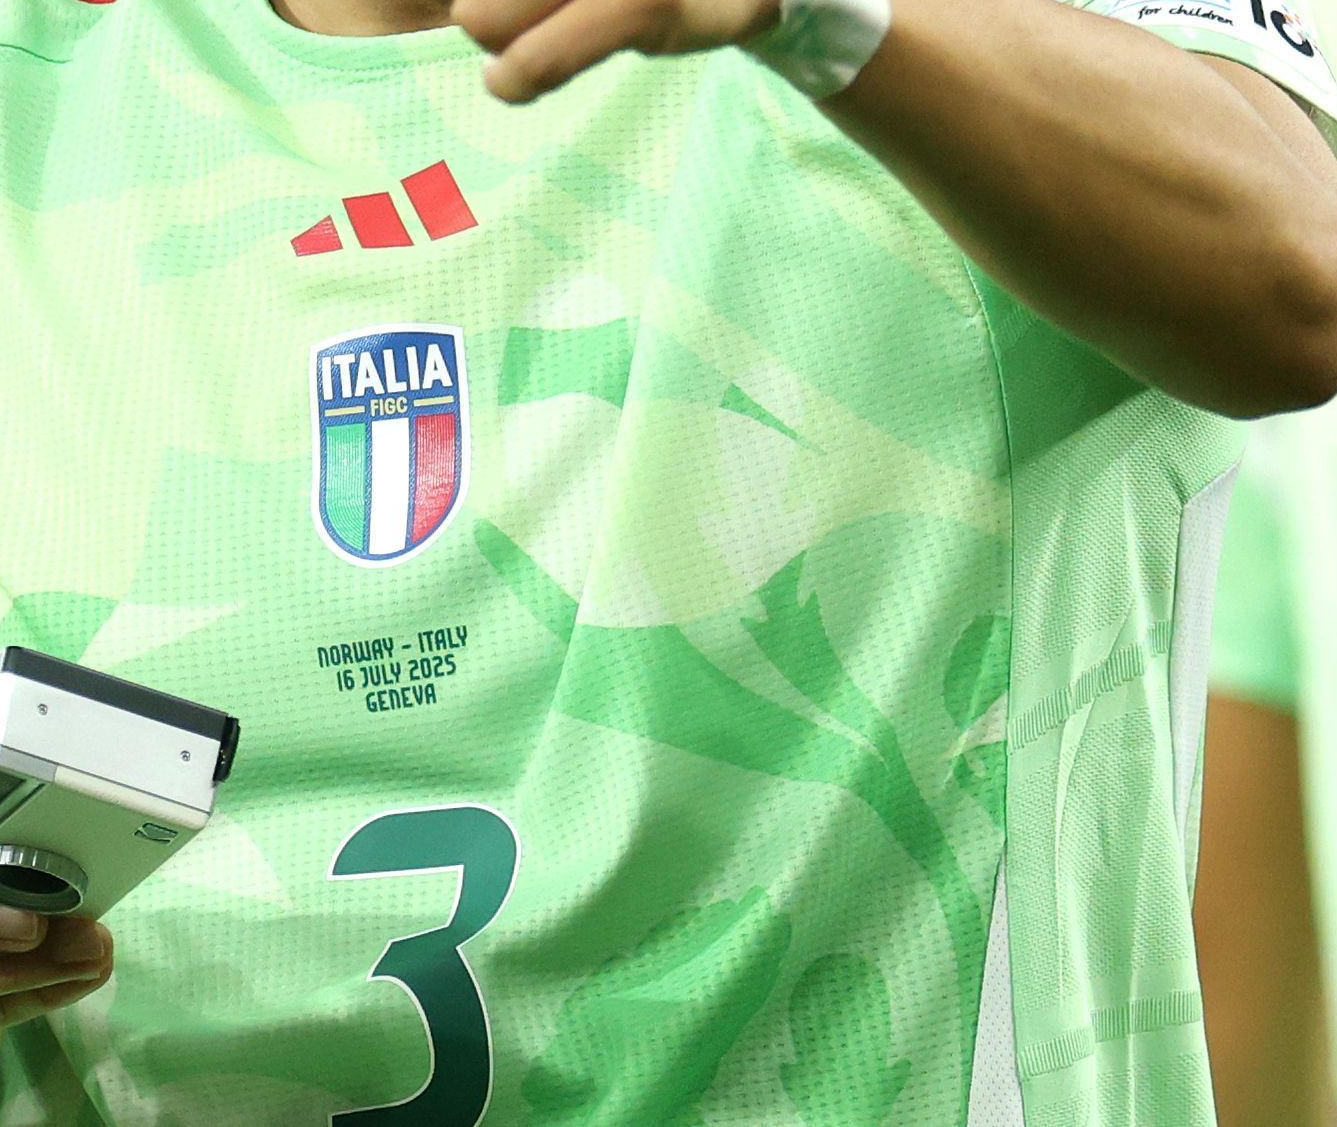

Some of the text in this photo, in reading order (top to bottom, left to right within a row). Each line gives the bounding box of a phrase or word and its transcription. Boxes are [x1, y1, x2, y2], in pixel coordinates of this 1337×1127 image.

[1138, 4, 1234, 26] for children
[321, 343, 454, 401] ITALIA
[370, 396, 408, 417] FIGC
[317, 637, 394, 668] NORWAY
[417, 625, 468, 653] ITALY
[336, 653, 457, 692] 16 JULY 2025
[365, 683, 437, 713] GENEVA
[326, 802, 521, 1127] 3
